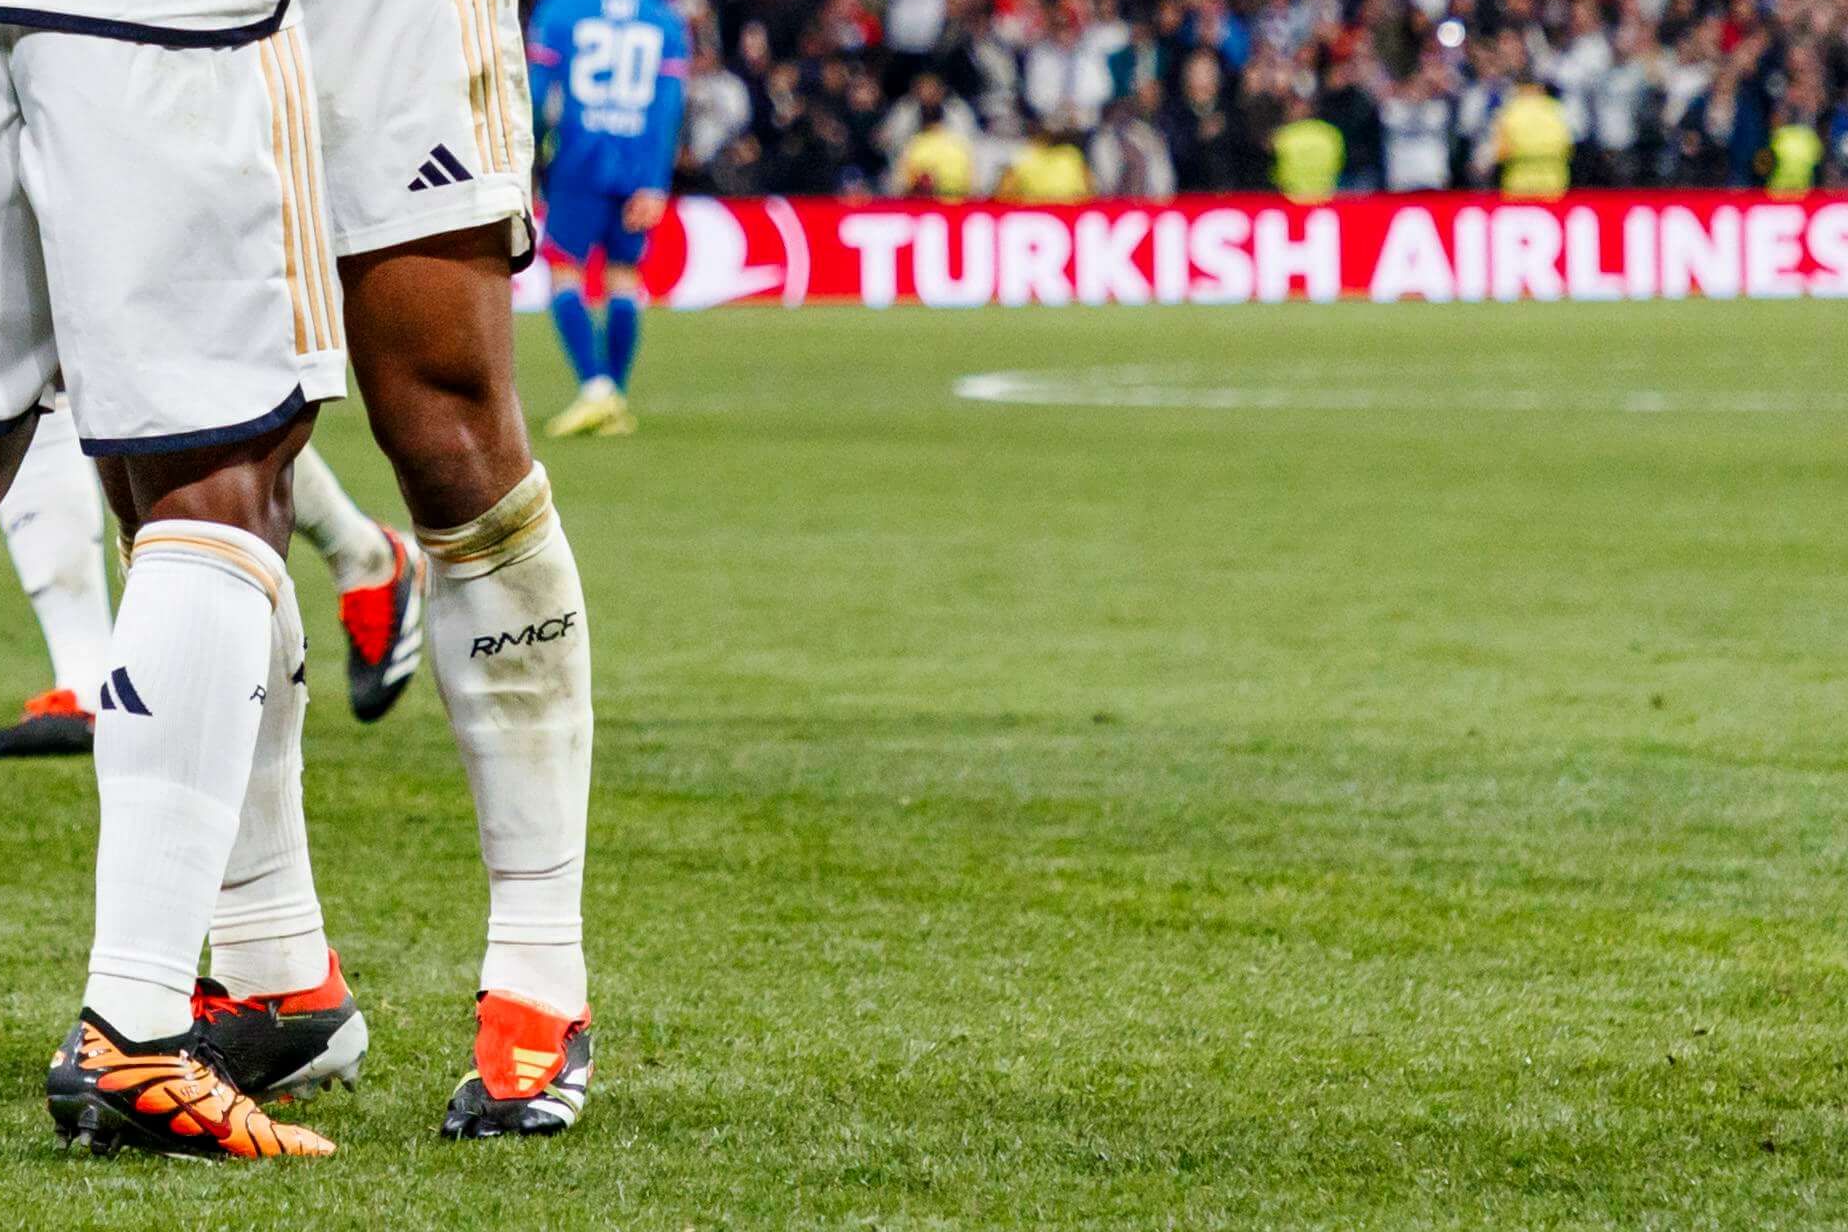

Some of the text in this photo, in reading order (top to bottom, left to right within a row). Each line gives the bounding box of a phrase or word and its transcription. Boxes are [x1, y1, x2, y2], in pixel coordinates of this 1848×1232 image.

[570, 17, 663, 109] 20
[838, 202, 1848, 308] TURKISH AIRLINES
[469, 611, 577, 658] RMCF
